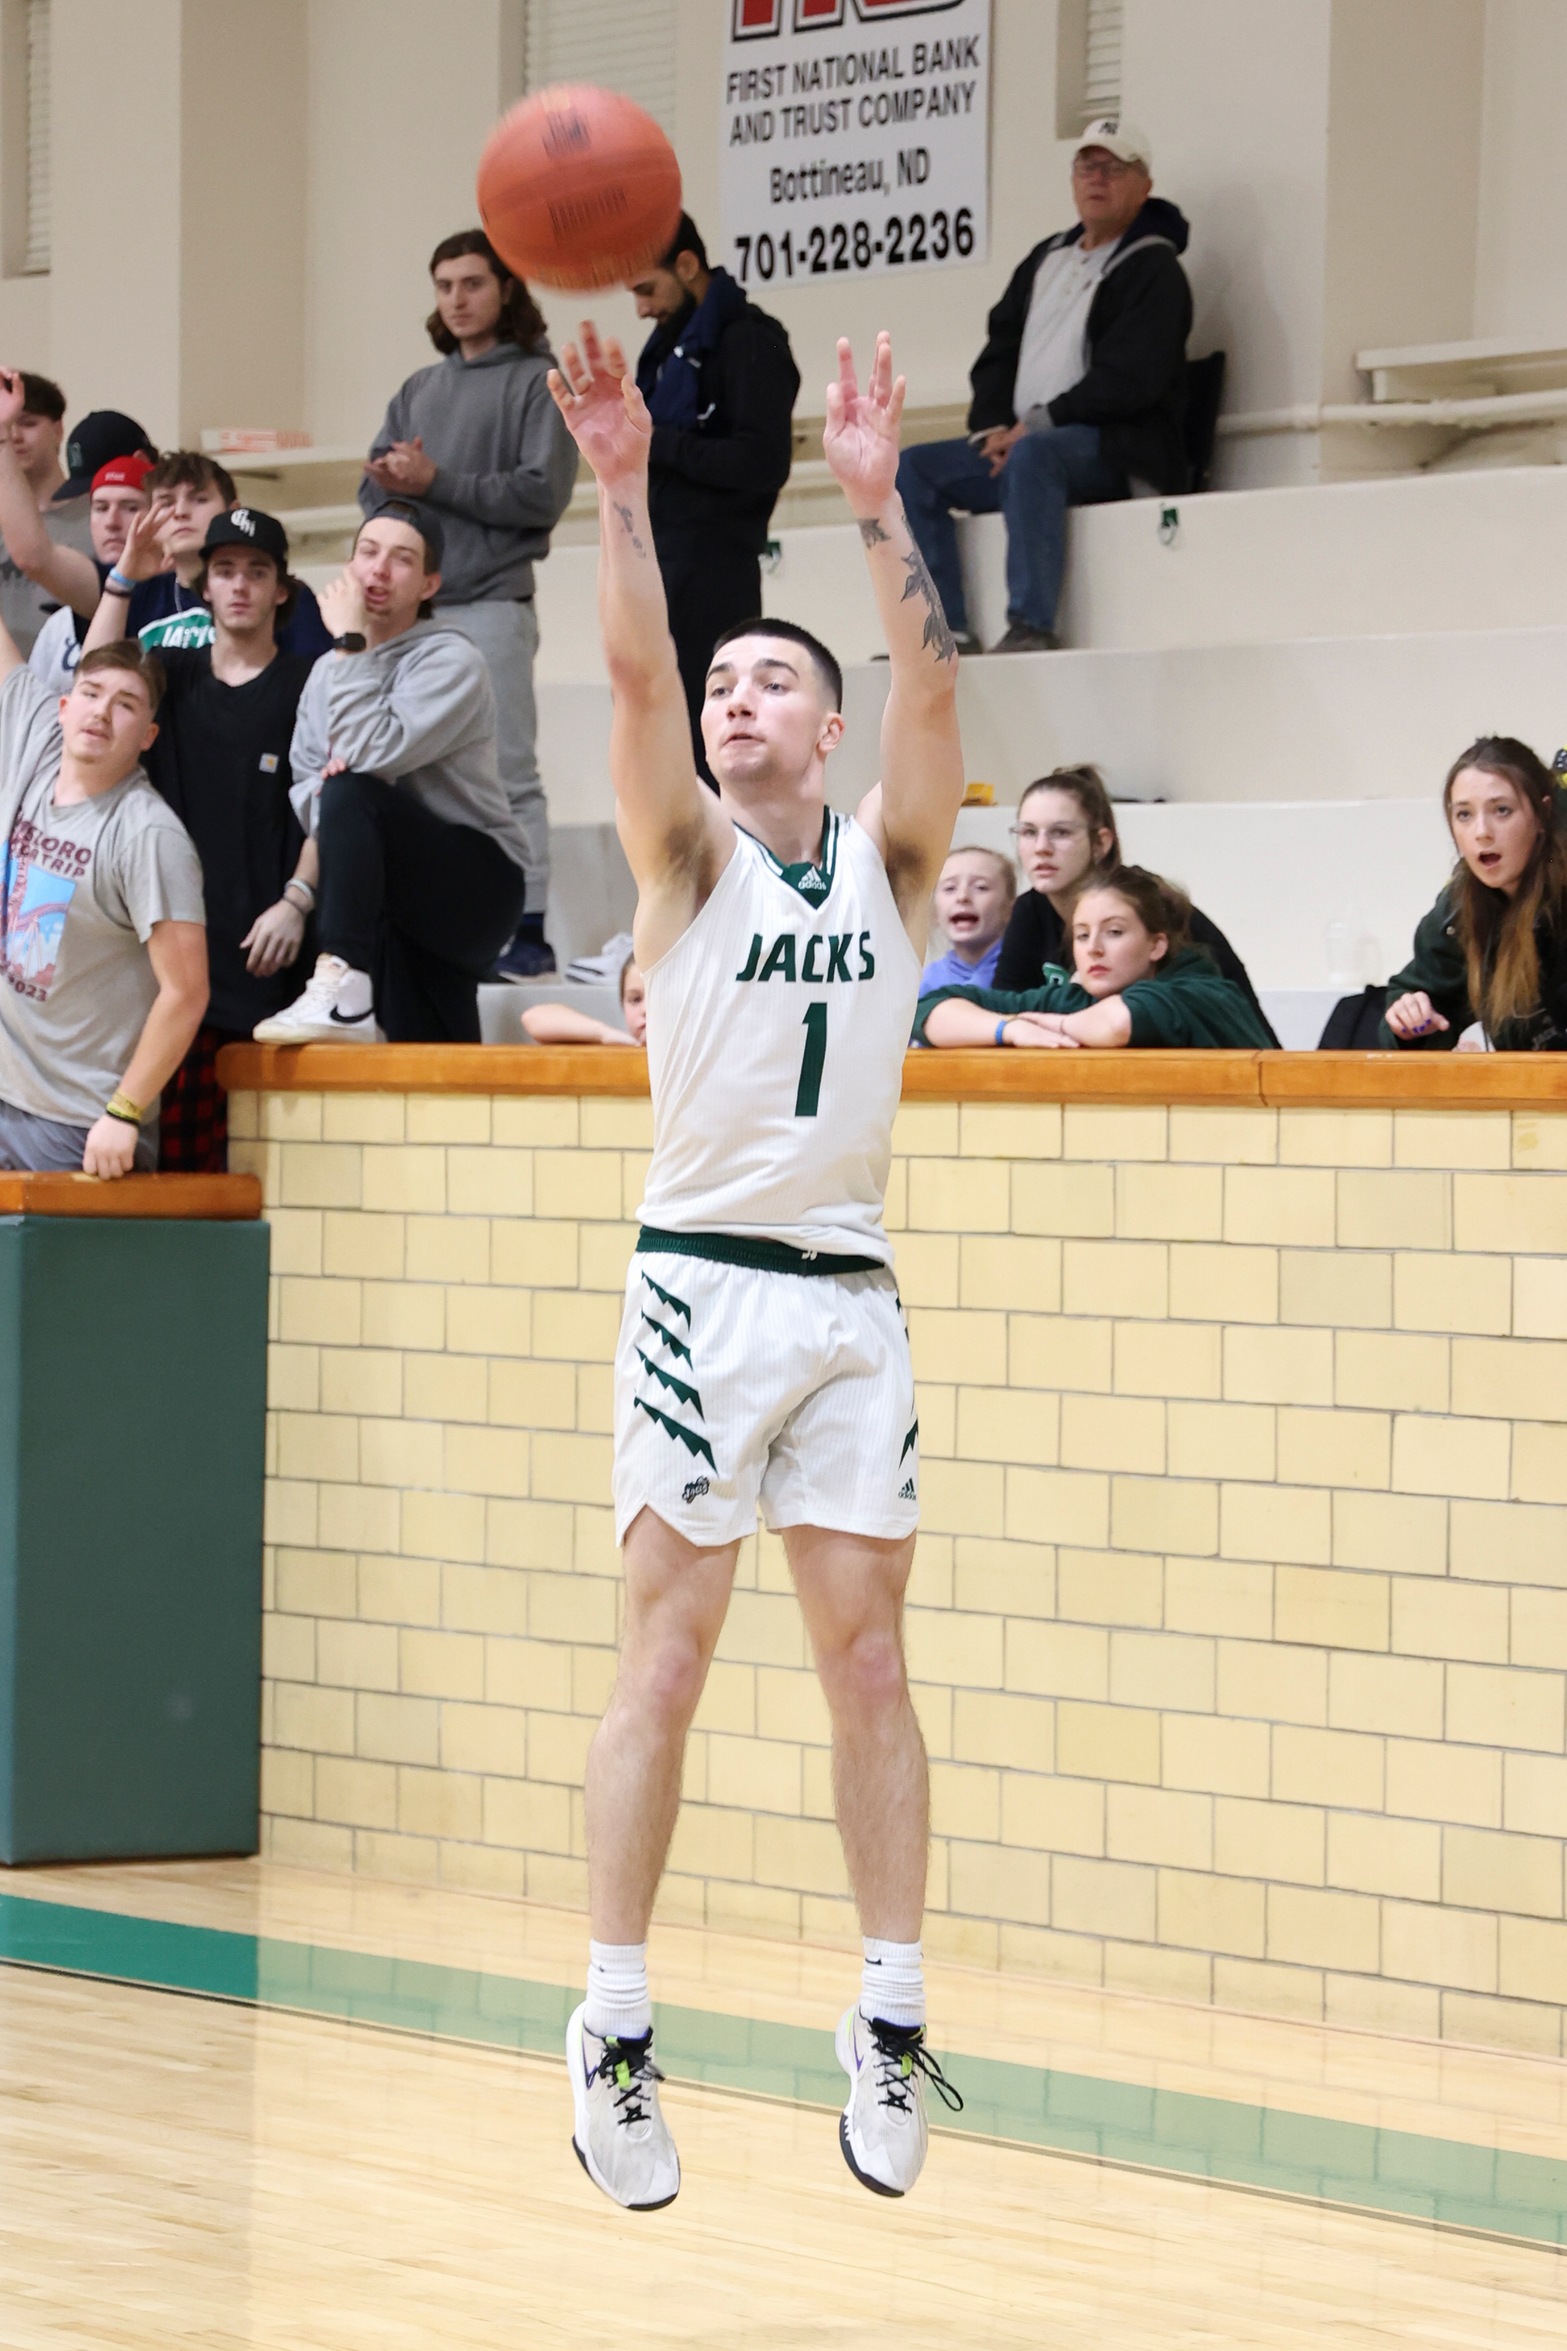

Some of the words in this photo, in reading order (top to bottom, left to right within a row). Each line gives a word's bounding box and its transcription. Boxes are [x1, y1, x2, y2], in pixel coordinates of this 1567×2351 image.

[726, 64, 788, 104] FIRST
[792, 48, 905, 93] NATIONAL
[912, 34, 981, 77] BANK
[730, 108, 775, 147] AND
[781, 98, 851, 139] TRUST
[859, 80, 977, 127] COMPANY
[769, 158, 891, 204] Bottineau,
[897, 147, 930, 187] ND
[735, 207, 974, 282] 701-228-2236
[735, 931, 875, 983] JACKS
[794, 1002, 828, 1117] 1
